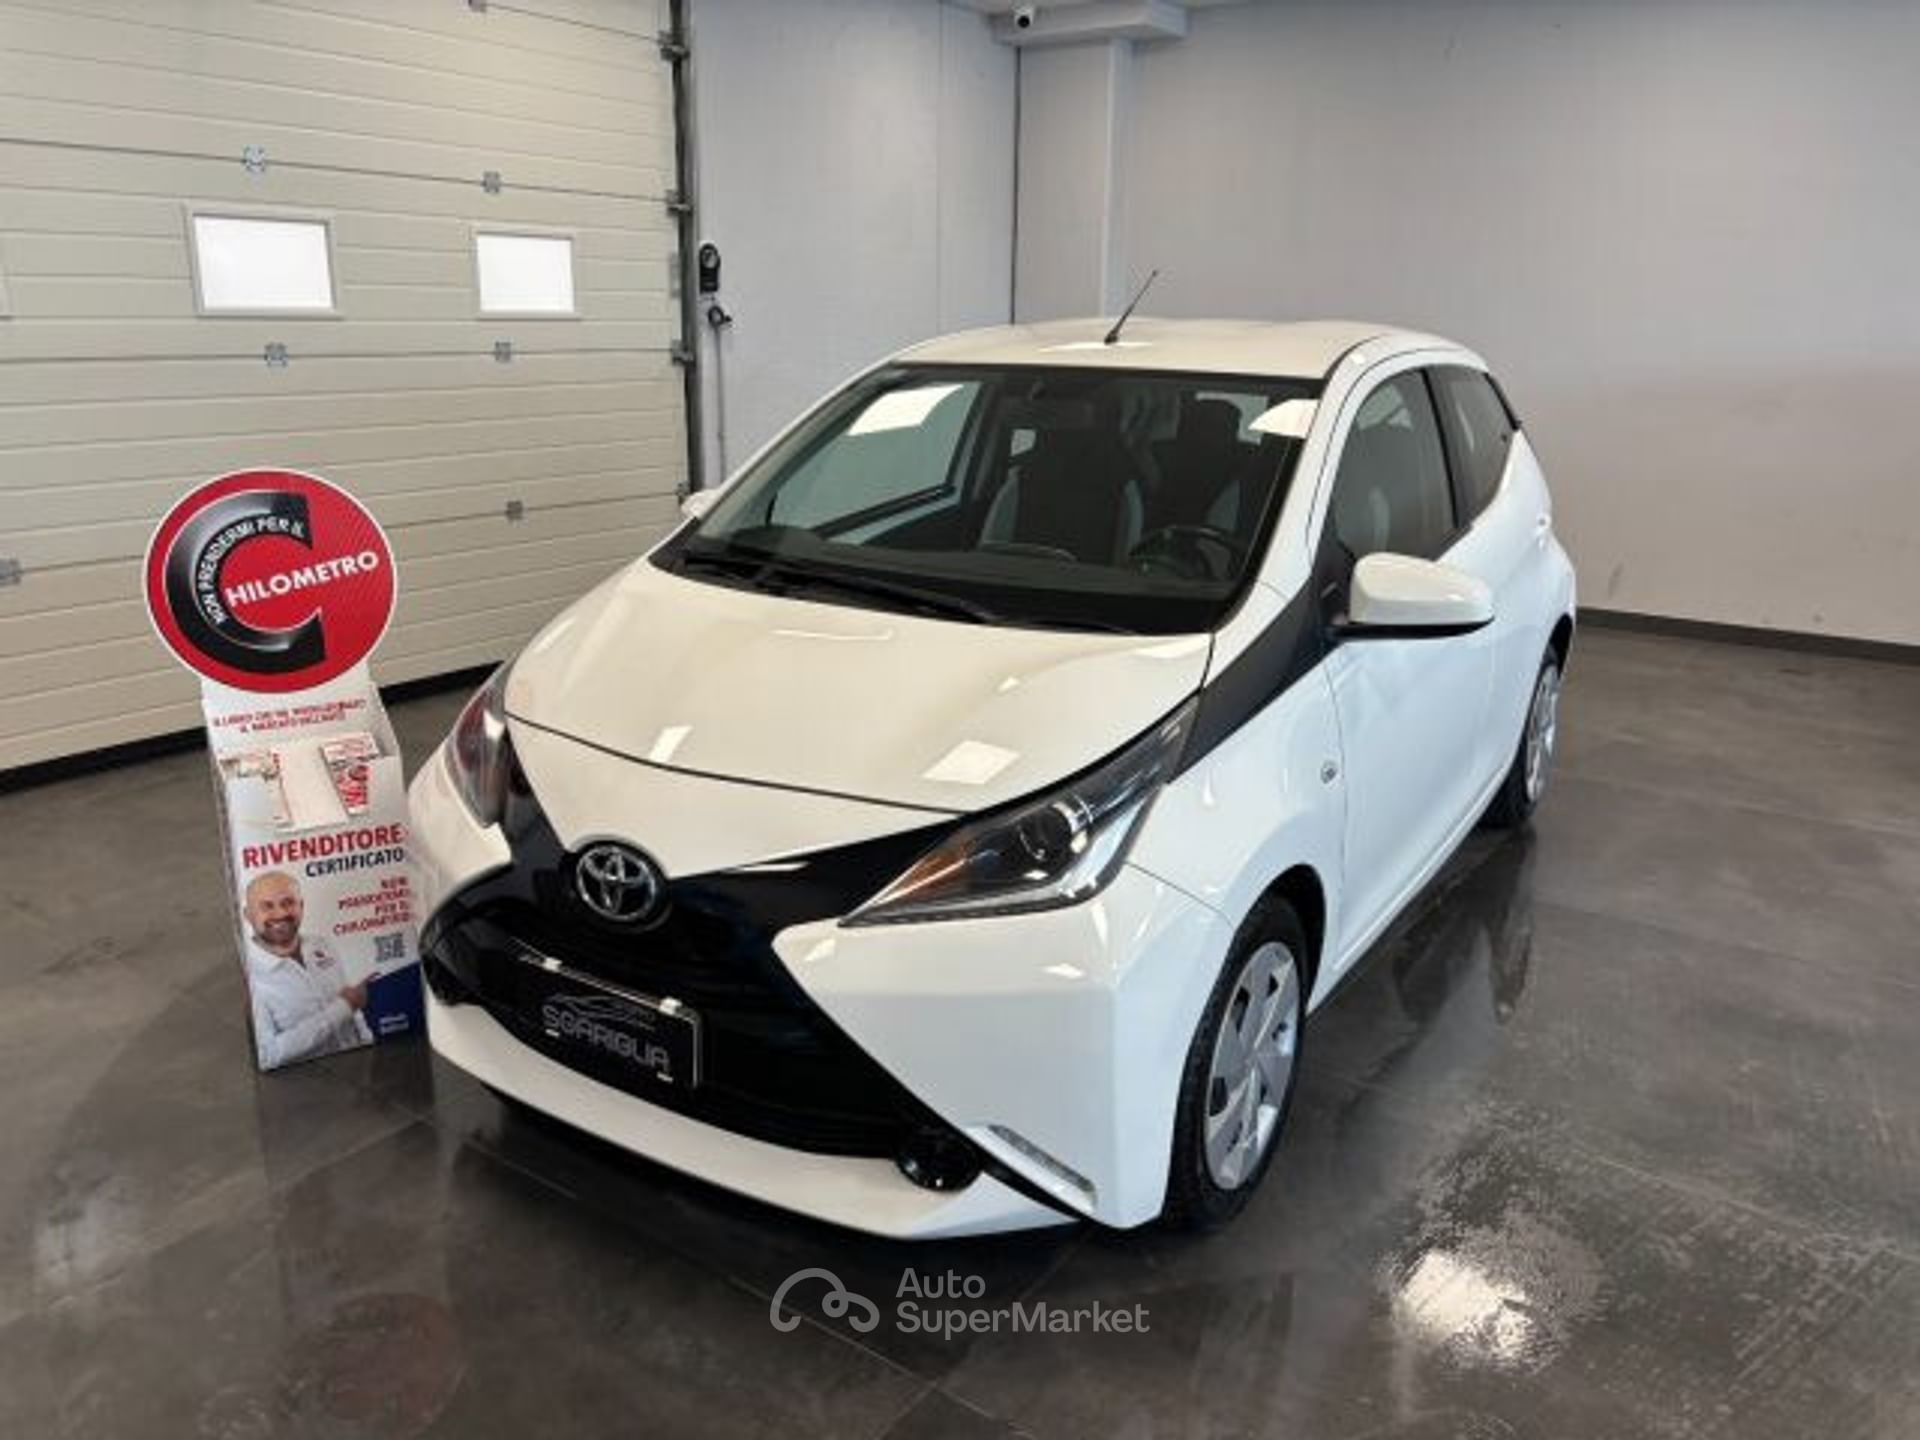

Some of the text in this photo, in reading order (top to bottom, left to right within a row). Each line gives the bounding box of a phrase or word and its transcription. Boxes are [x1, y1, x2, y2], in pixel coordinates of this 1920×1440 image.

[225, 551, 379, 607] HILOMETRO
[243, 824, 403, 868] RIVENDITORE
[305, 848, 404, 878] CERTIFICATO
